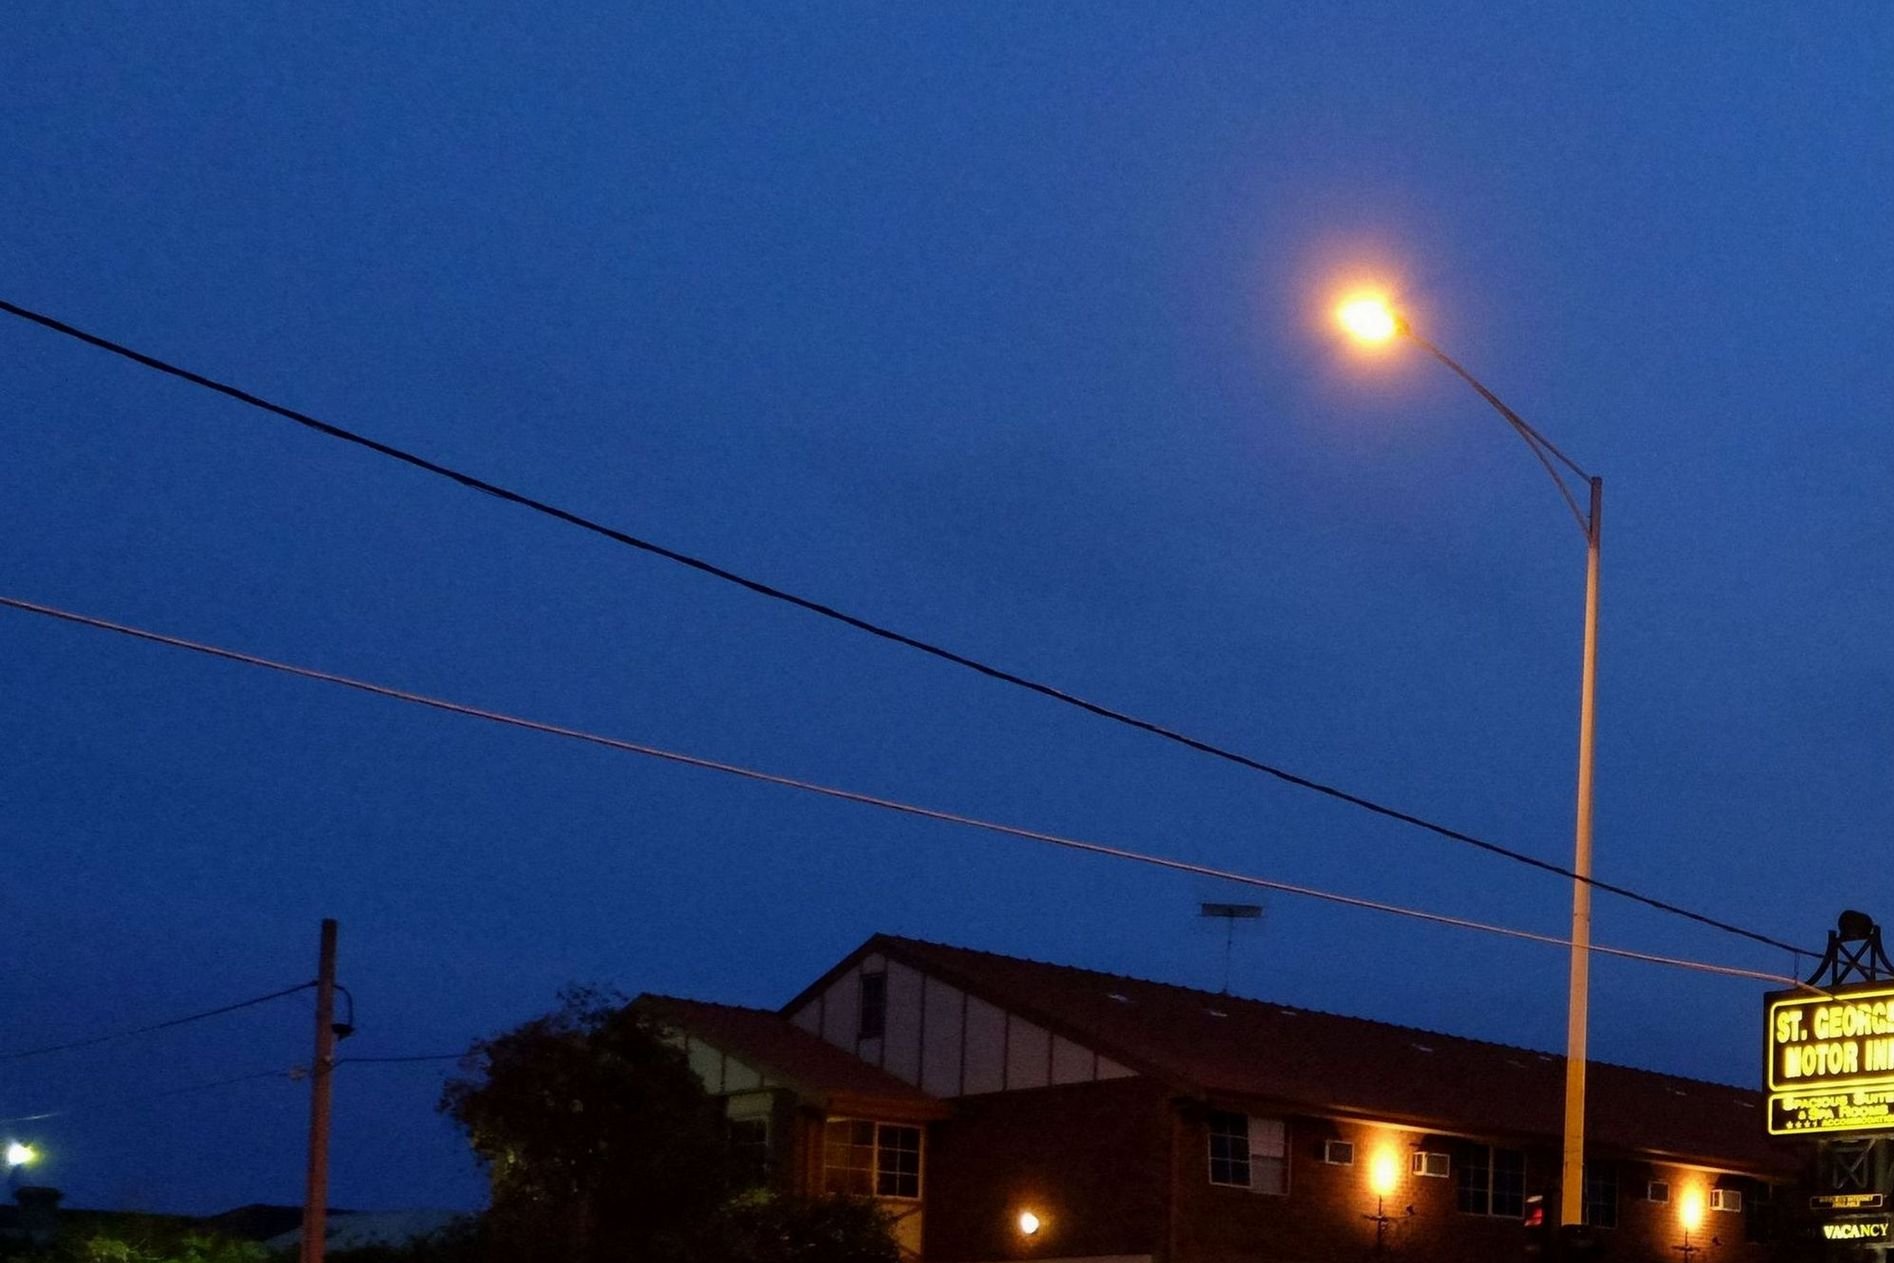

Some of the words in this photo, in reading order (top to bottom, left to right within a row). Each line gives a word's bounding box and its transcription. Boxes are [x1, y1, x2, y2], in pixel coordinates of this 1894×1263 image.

[1776, 1010, 1807, 1043] ST.
[1784, 1042, 1858, 1078] MOTOR
[1823, 1223, 1889, 1239] VACANCY
